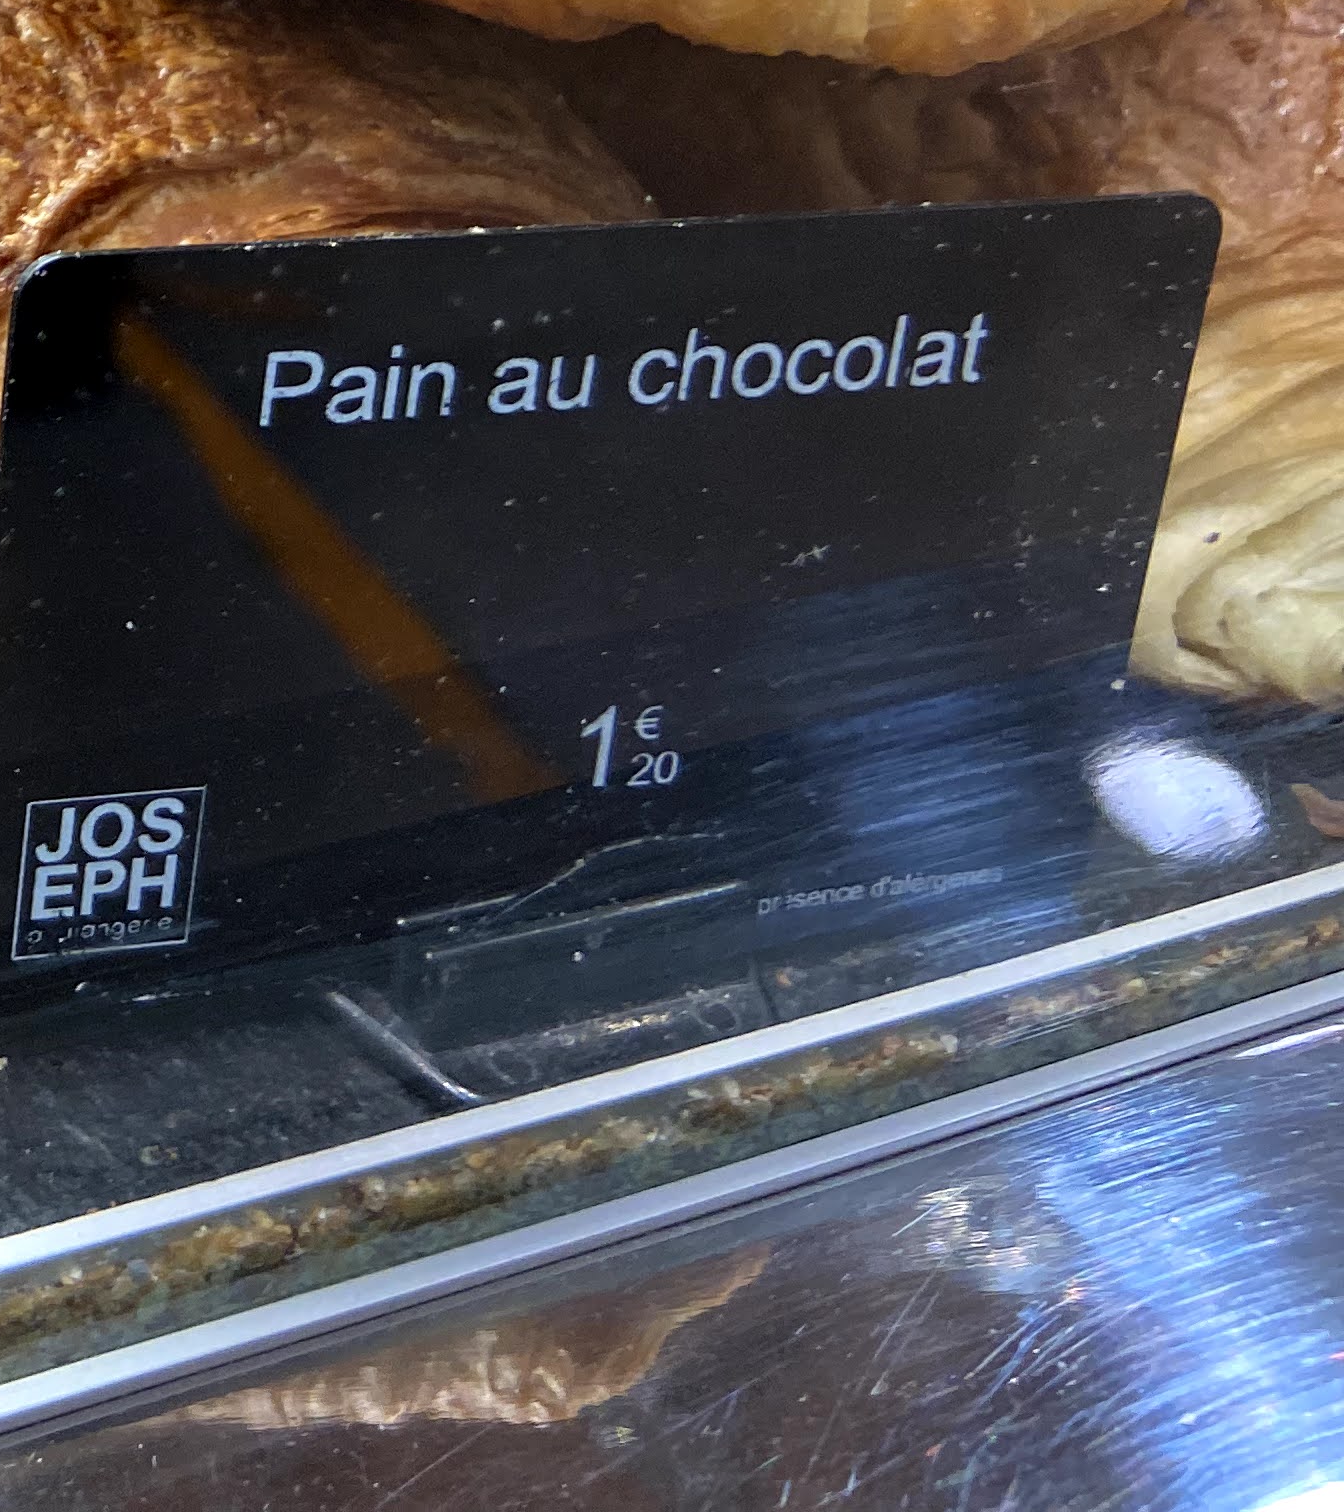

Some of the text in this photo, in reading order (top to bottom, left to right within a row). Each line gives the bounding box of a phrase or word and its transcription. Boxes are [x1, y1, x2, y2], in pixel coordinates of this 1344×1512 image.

[260, 313, 988, 427] Pain au chocolat
[580, 705, 664, 787] 1 €
[625, 751, 679, 786] 20
[34, 797, 185, 863] JOS
[30, 854, 179, 920] EPH
